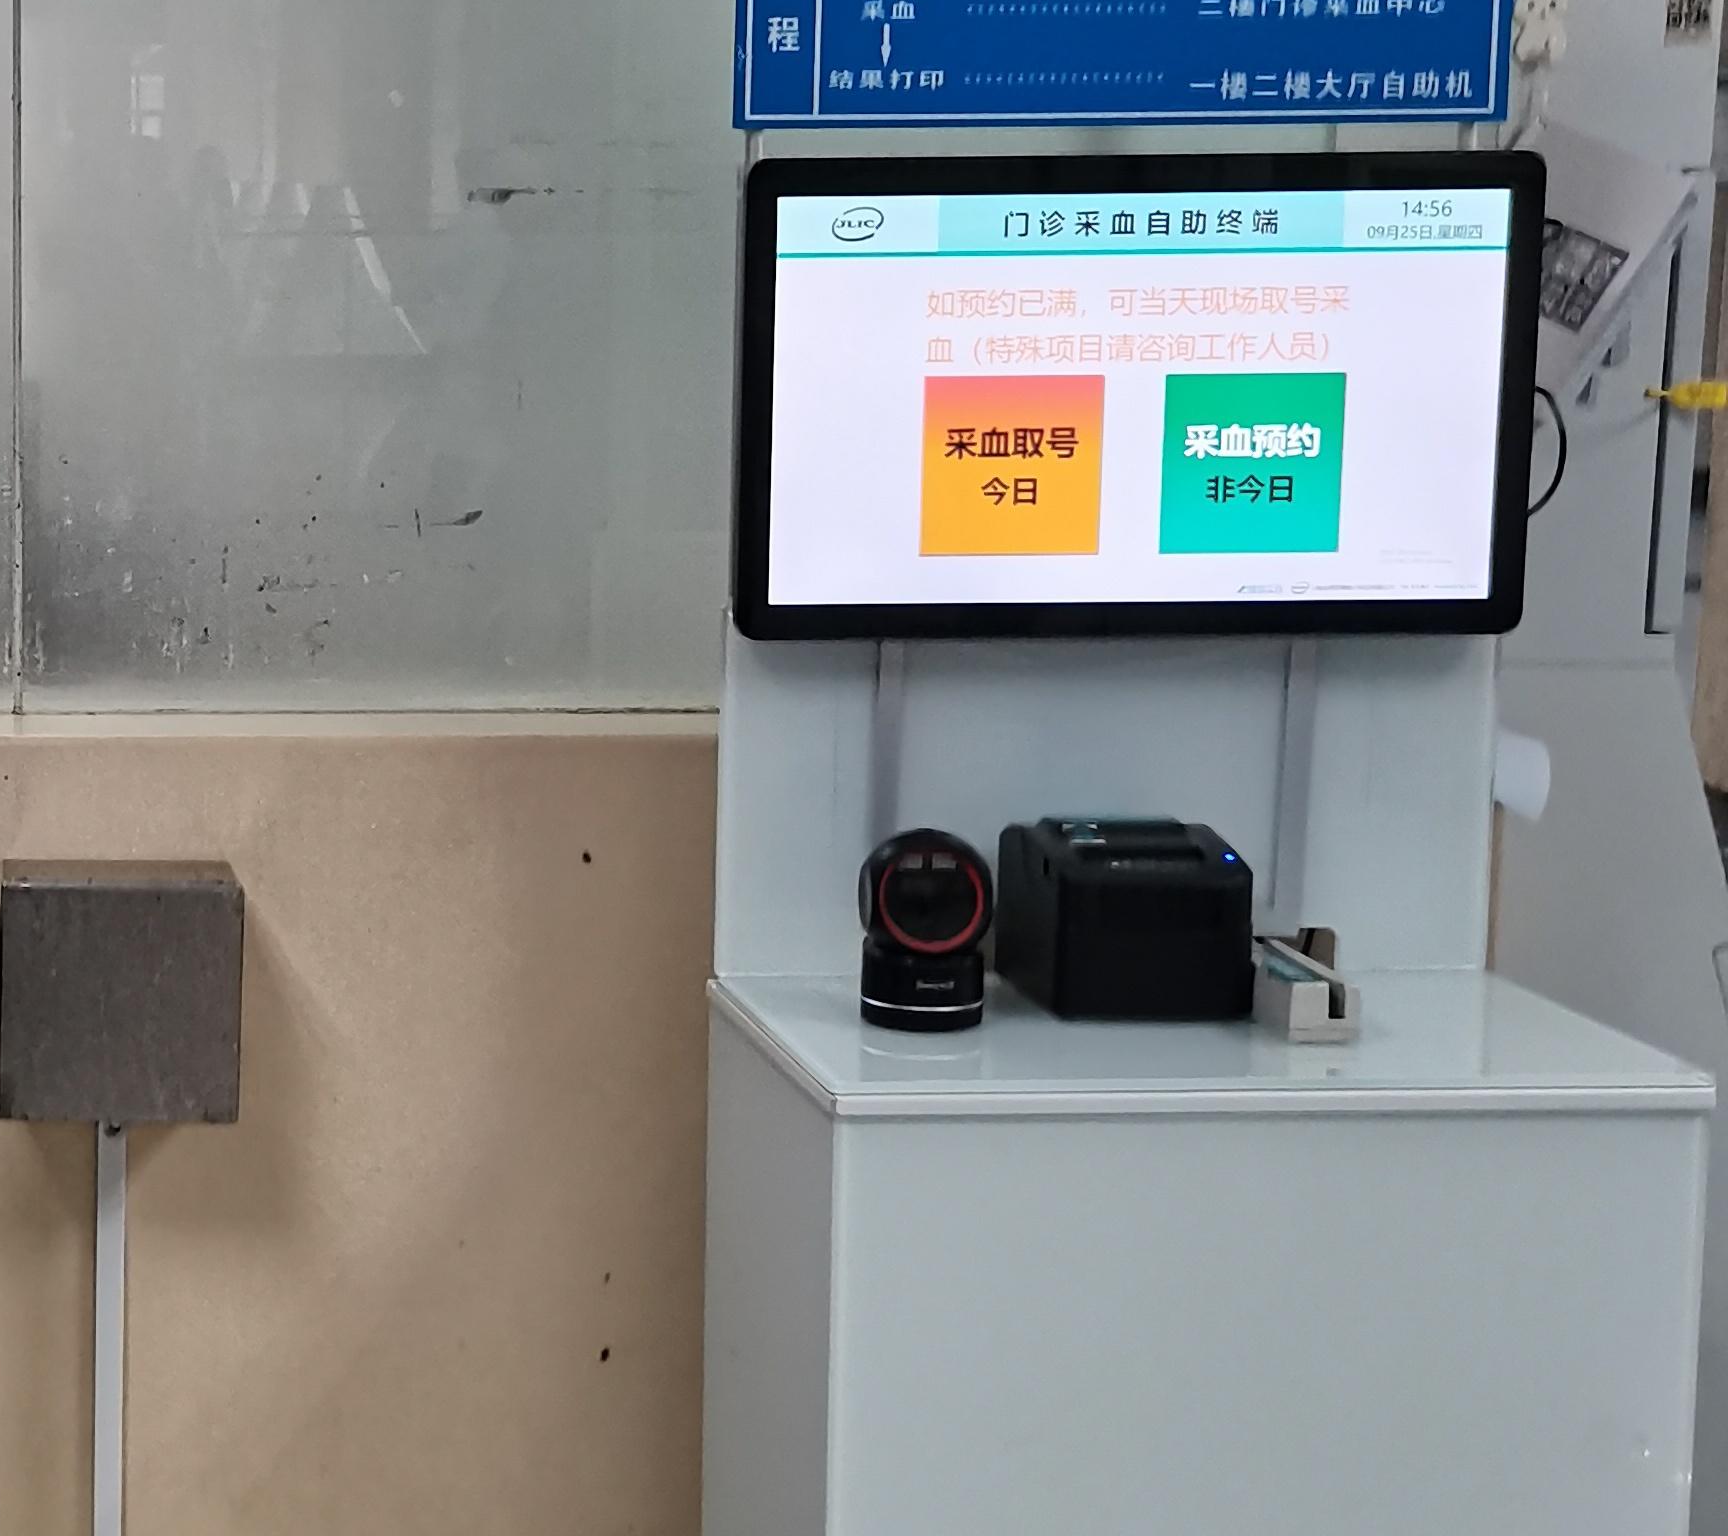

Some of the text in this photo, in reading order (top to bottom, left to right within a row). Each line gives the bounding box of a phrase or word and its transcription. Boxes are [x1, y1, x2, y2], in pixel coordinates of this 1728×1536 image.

[863, 0, 915, 20] 采血
[829, 69, 1472, 100] 结果打印 一楼二楼大厅自助机
[1403, 200, 1452, 217] 14:56
[834, 218, 876, 228] JLIC
[1004, 209, 1278, 237] 门诊采血自助终端
[945, 427, 1079, 459] 采血取号
[1184, 423, 1321, 459] 采血预约
[981, 477, 1037, 505] 今日
[1206, 475, 1293, 503] 非今日
